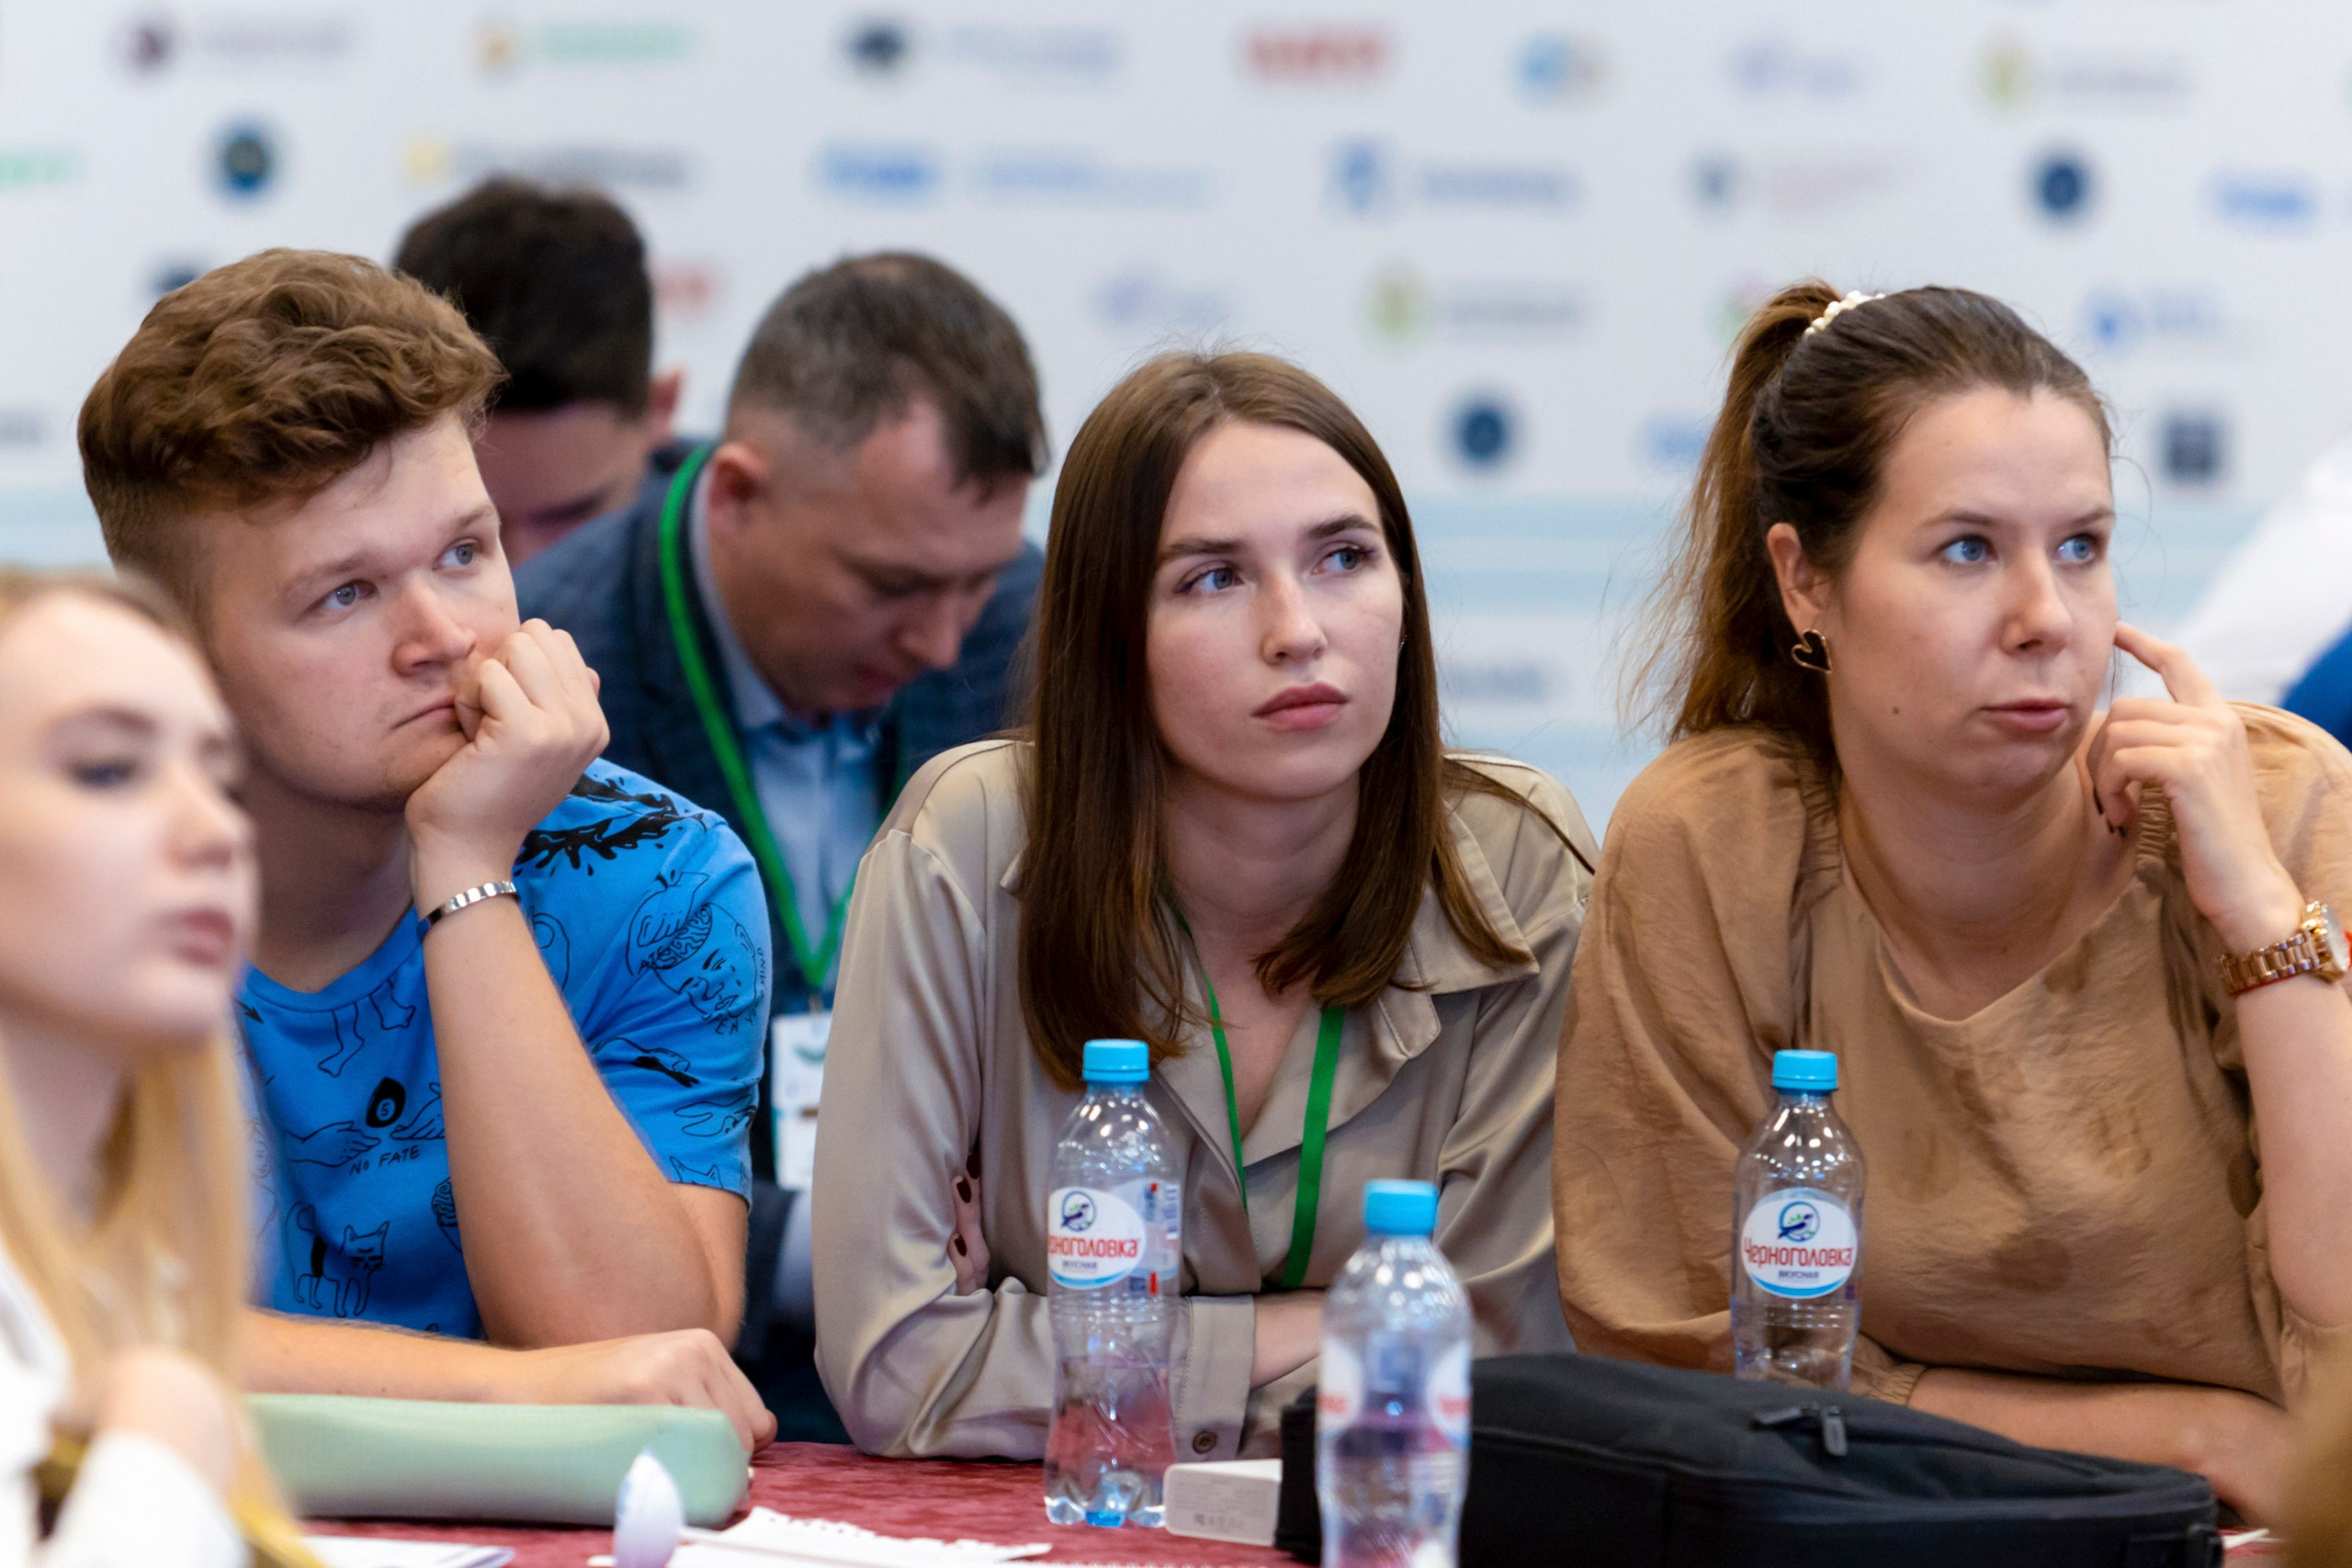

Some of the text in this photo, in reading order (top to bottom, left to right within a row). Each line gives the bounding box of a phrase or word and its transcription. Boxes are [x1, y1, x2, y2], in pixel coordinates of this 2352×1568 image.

[349, 1145, 420, 1175] NO FATE
[1744, 1237, 1852, 1268] Черноголовка
